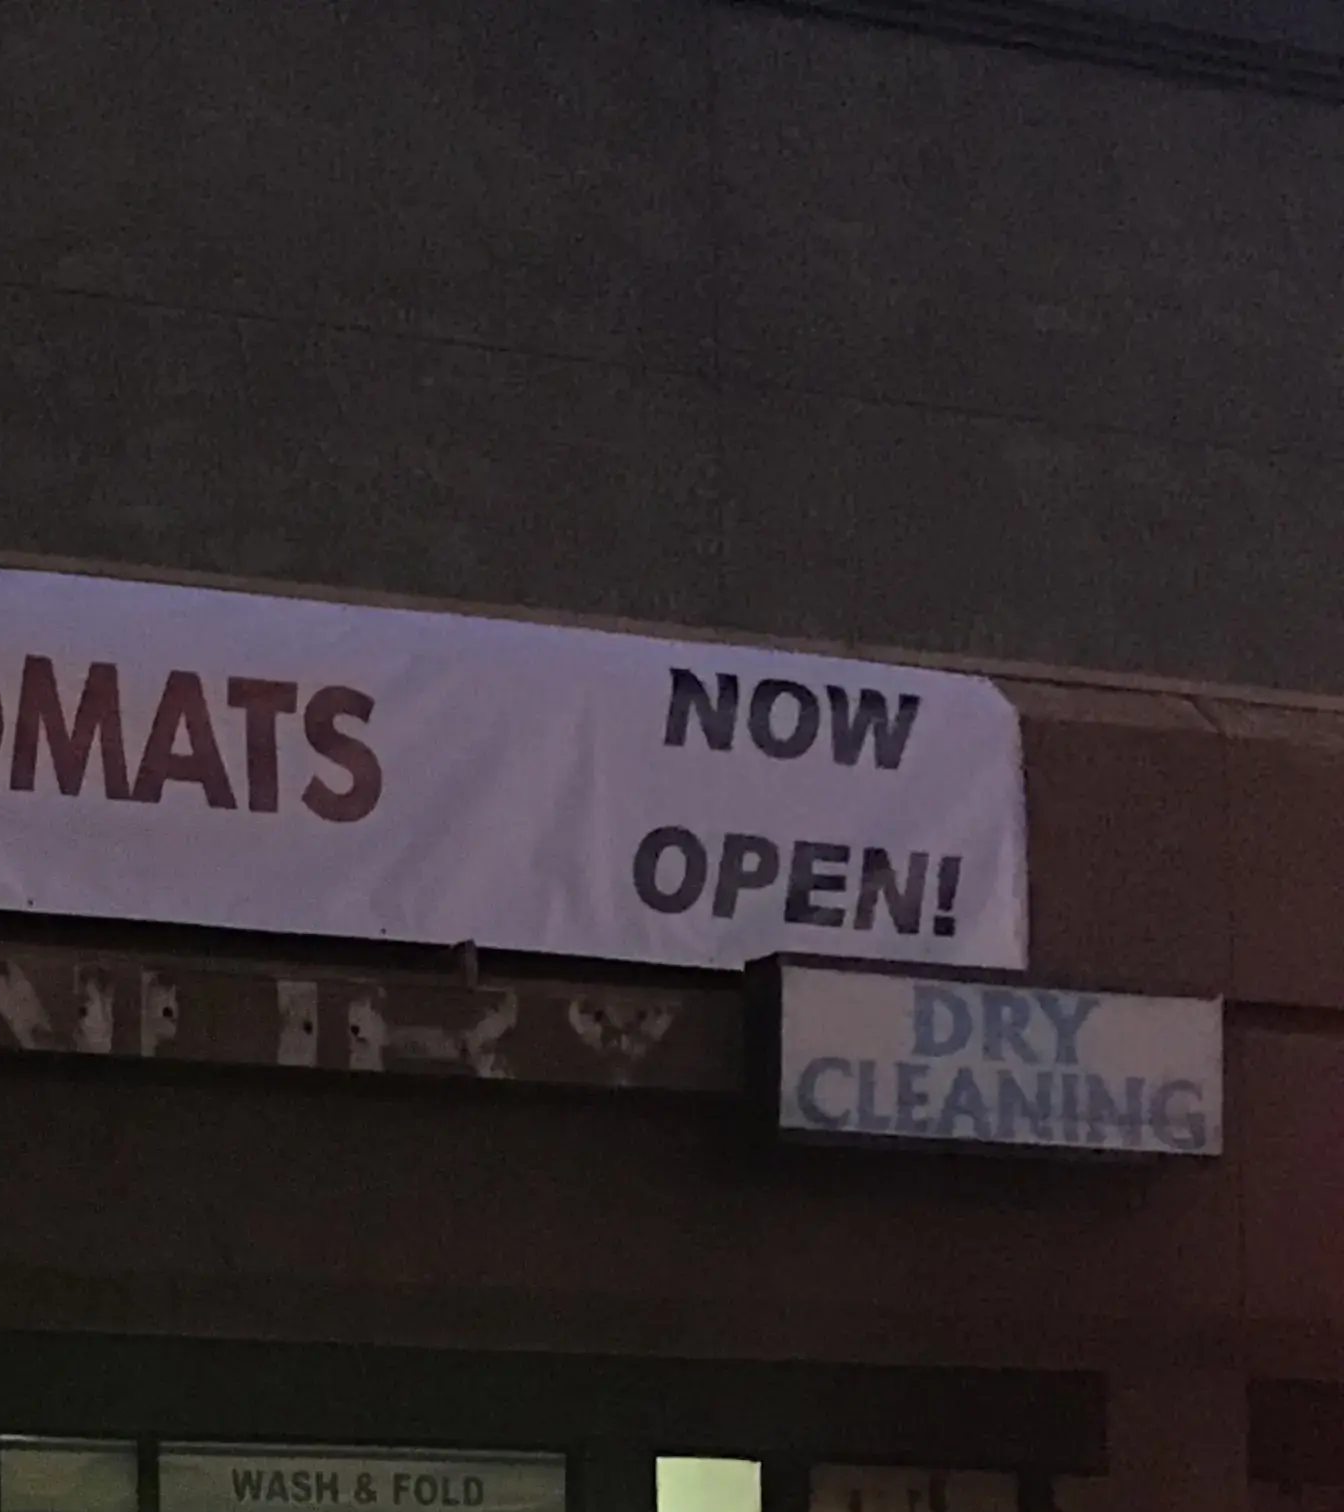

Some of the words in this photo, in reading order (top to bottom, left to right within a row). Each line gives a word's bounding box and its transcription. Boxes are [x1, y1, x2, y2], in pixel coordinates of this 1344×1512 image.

[664, 667, 920, 770] NOW
[632, 825, 962, 937] OPEN!
[910, 984, 1100, 1067] DRY
[796, 1055, 1207, 1151] CLEANING
[231, 1468, 340, 1505] WASH
[353, 1472, 378, 1505] &
[392, 1472, 485, 1507] FOLD
